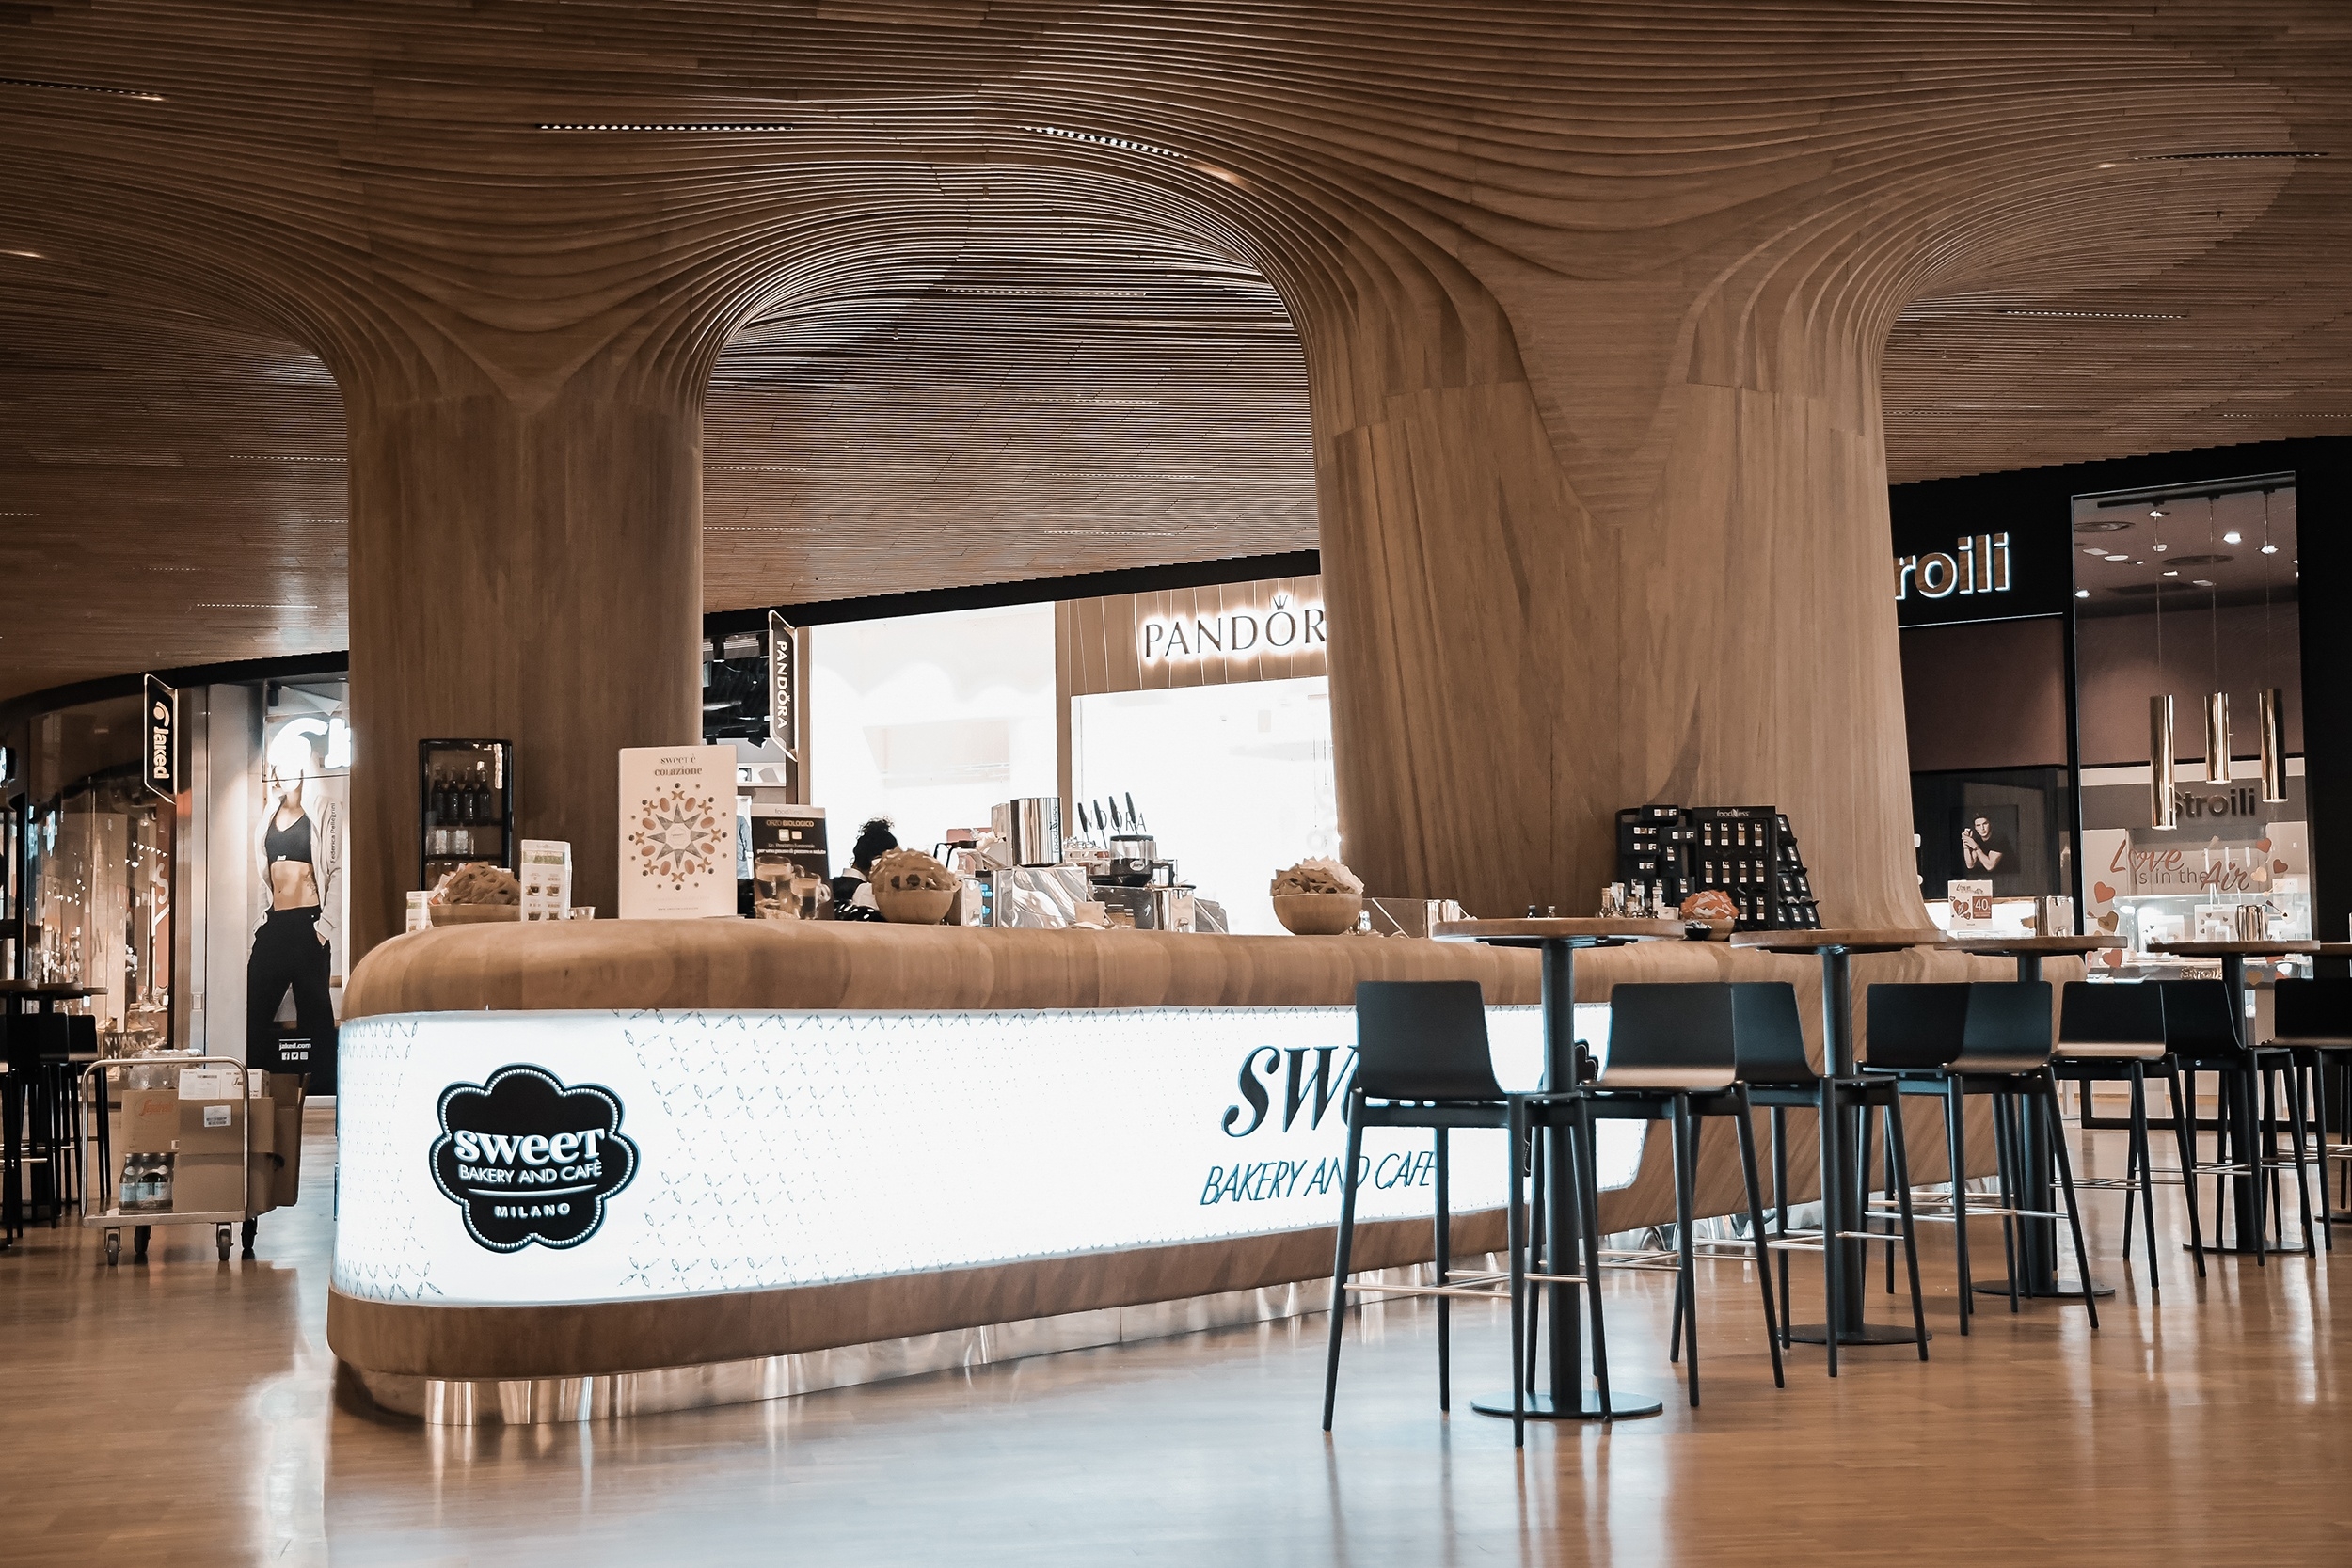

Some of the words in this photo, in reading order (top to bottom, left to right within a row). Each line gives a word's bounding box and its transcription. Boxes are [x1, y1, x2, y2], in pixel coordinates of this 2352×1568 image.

[1893, 531, 2010, 600] roili
[1146, 608, 1327, 657] PANDOR
[777, 641, 788, 729] PANDORA
[153, 726, 169, 779] Jaked
[1086, 810, 1147, 832] NDORA
[2109, 839, 2185, 873] Love
[2155, 867, 2171, 884] in
[2200, 860, 2250, 891] Air
[278, 1042, 311, 1051] jaked.com
[458, 1164, 515, 1183] BAKERY
[518, 1168, 558, 1184] AND
[1200, 1159, 1308, 1205] BAKERY
[494, 1203, 571, 1219] MILANO
